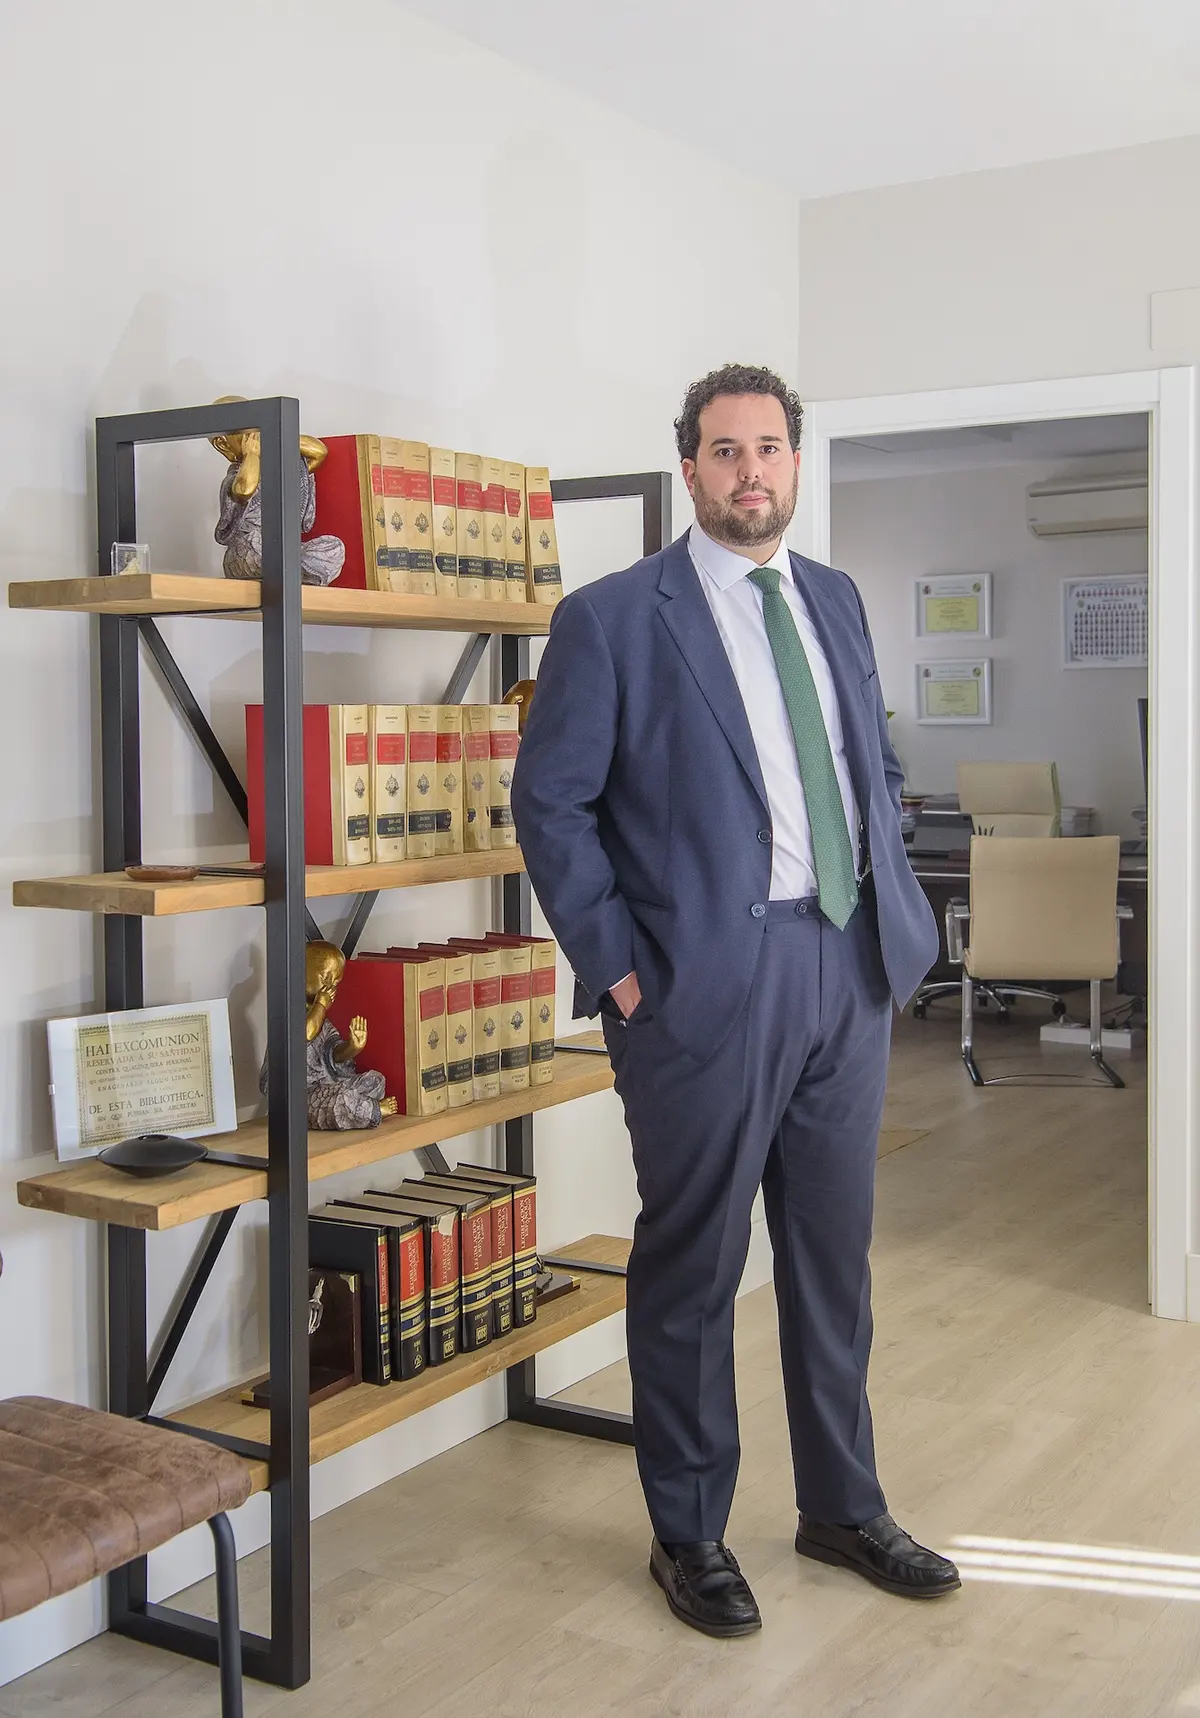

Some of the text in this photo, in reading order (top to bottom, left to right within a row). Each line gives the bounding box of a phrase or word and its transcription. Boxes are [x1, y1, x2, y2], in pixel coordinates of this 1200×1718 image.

[86, 1032, 200, 1057] HAI EXCOMUNION
[86, 1055, 134, 1068] RESERVADA
[160, 1046, 201, 1058] SANTIDAD
[89, 1104, 103, 1115] DE
[108, 1099, 133, 1112] ESTA
